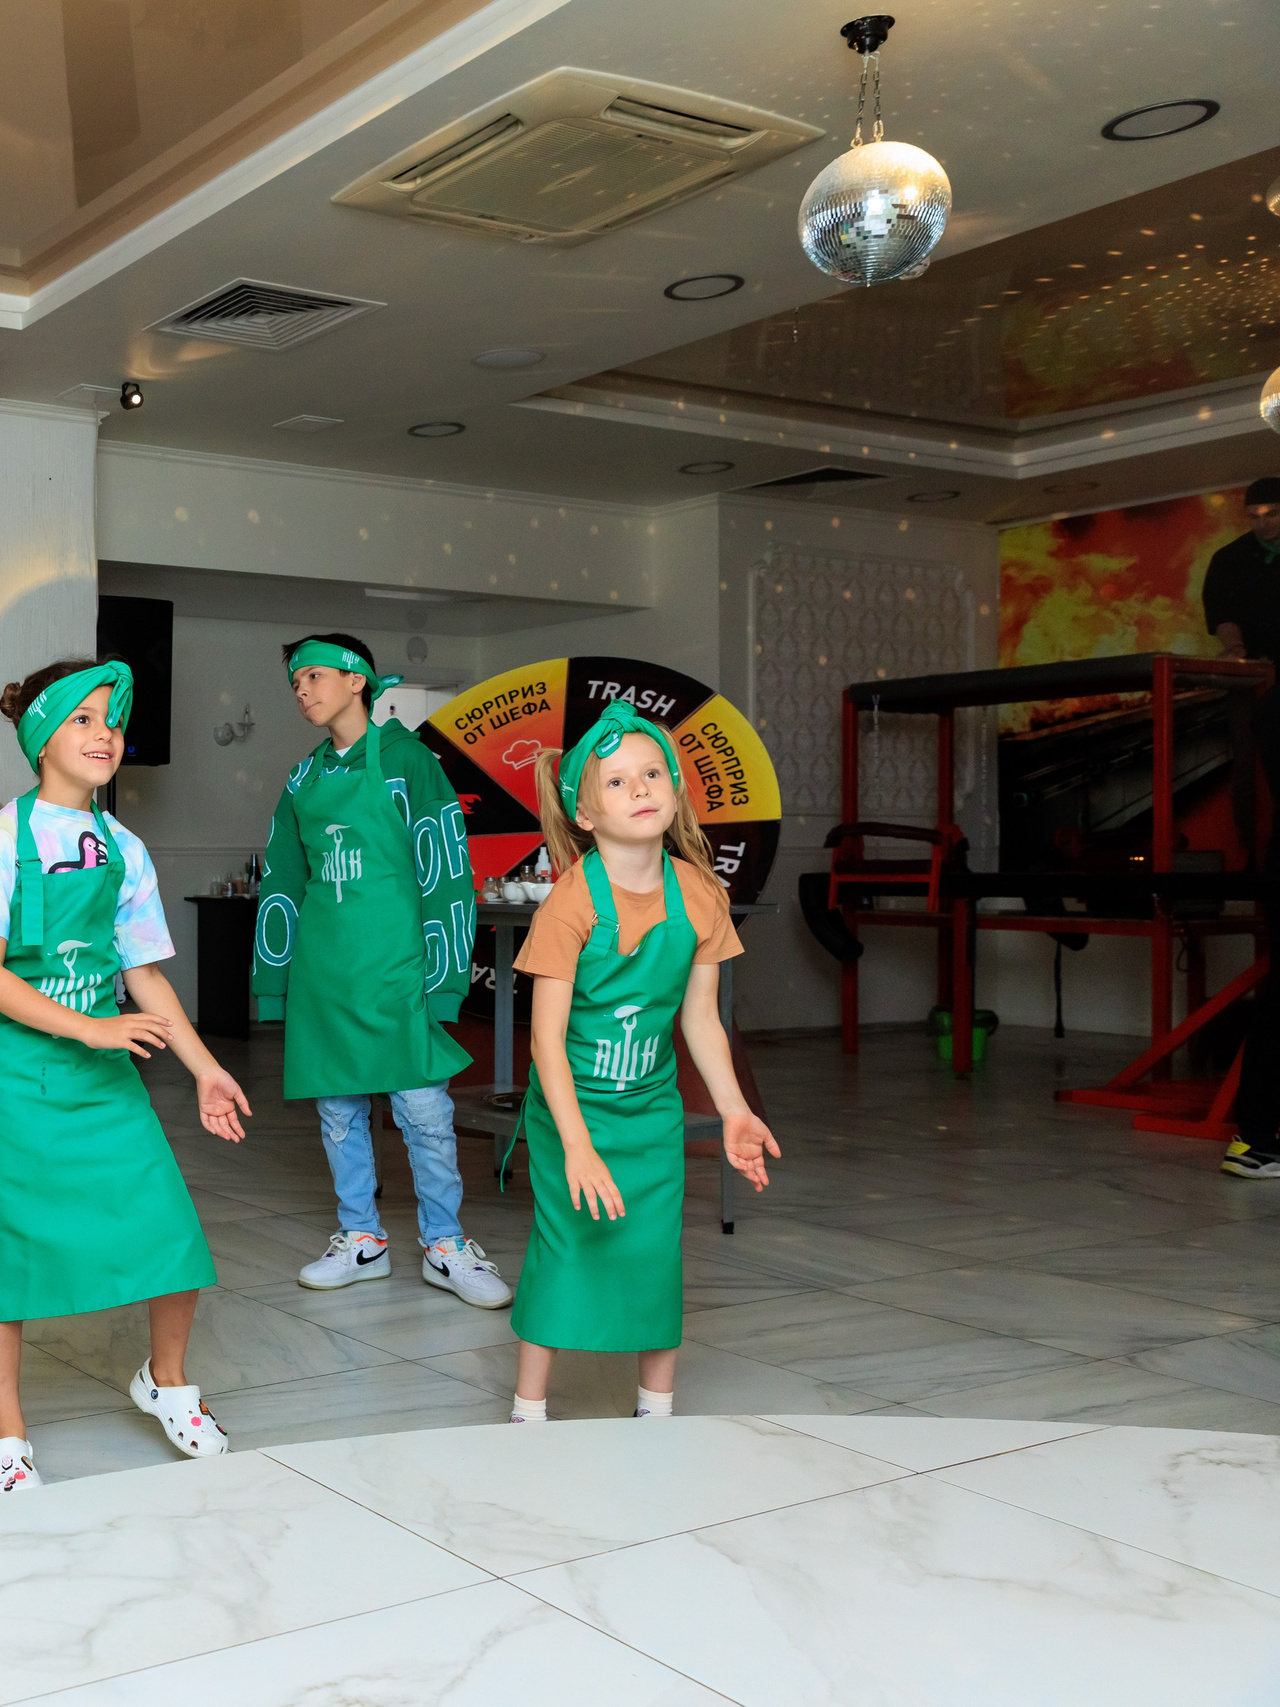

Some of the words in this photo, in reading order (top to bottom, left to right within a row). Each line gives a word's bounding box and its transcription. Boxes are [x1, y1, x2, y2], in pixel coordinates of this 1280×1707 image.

[454, 681, 547, 731] СЮРПРИЗ
[463, 723, 486, 745] ОТ
[489, 698, 551, 730] ШЕФА
[587, 680, 676, 717] TRASH
[679, 733, 705, 754] ОТ
[693, 755, 725, 813] ШЕФА
[700, 722, 749, 806] СЮРПРИЗ
